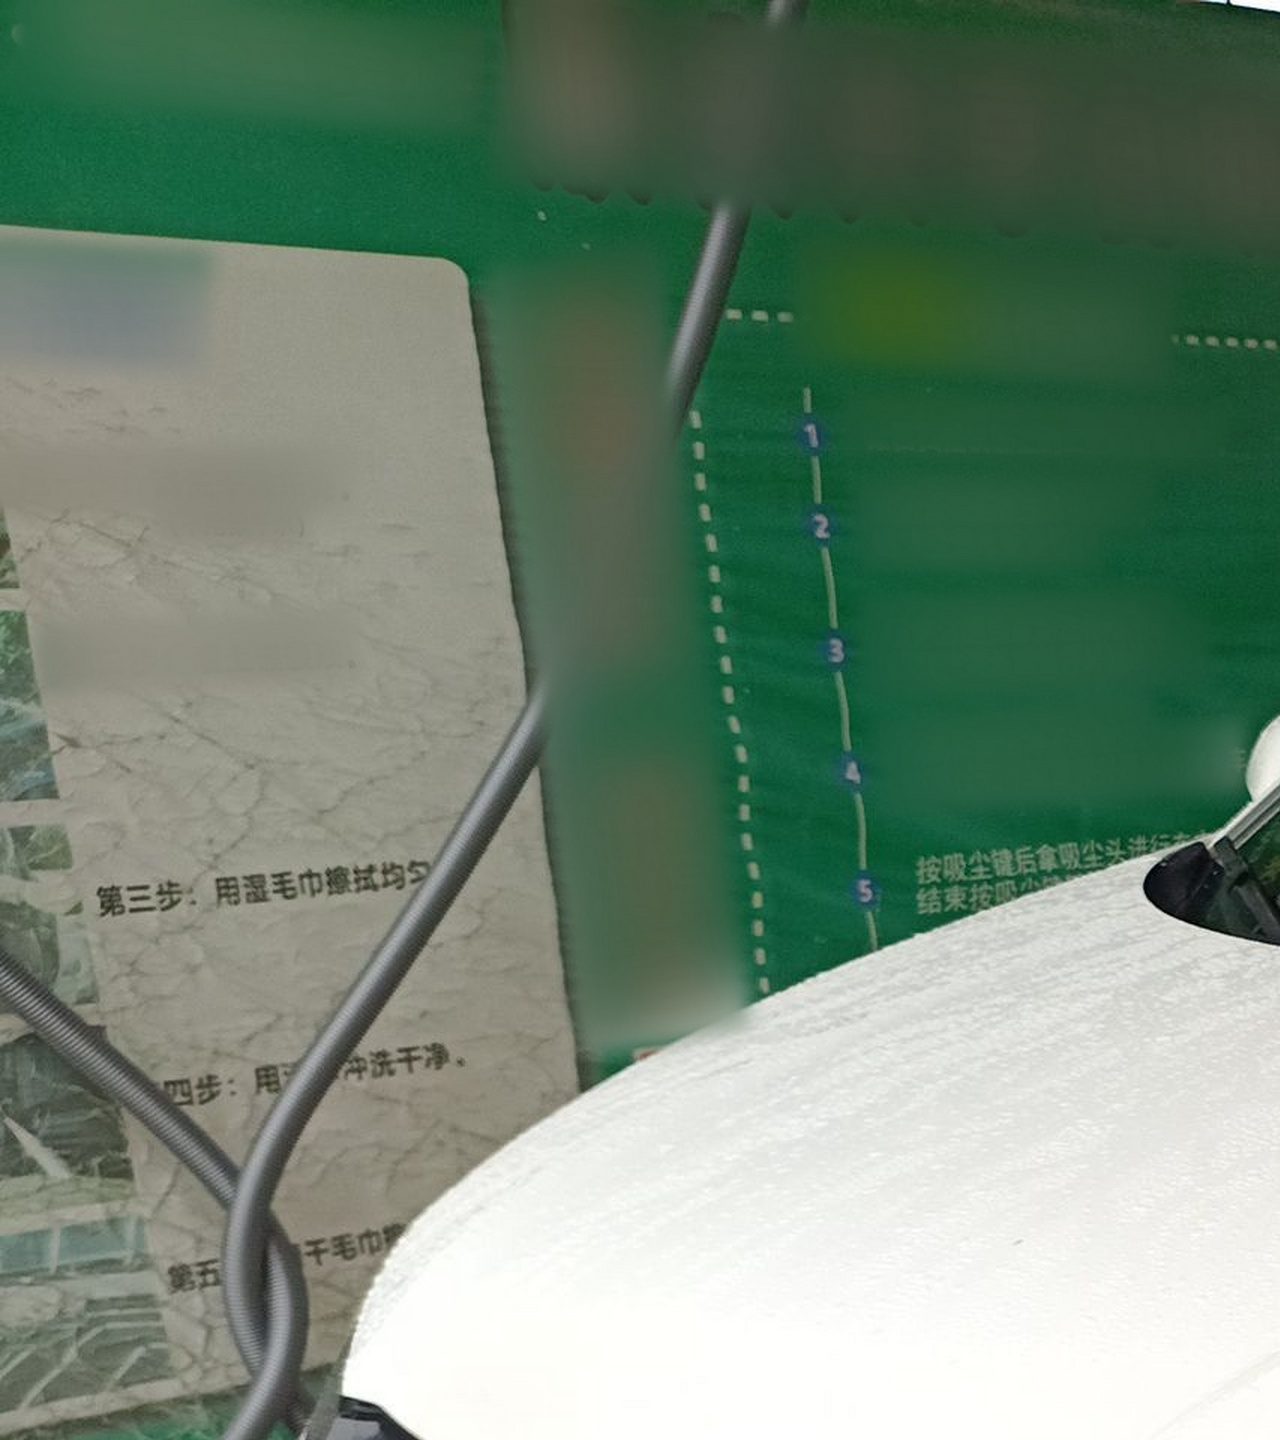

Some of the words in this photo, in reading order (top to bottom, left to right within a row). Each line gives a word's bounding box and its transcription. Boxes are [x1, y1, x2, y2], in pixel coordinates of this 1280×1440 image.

[804, 423, 818, 448] 1
[813, 514, 830, 539] 2
[829, 638, 845, 663] 3
[845, 761, 861, 785] 4
[915, 833, 1212, 884] 按吸尘键后拿吸尘头进行
[858, 879, 873, 903] 5
